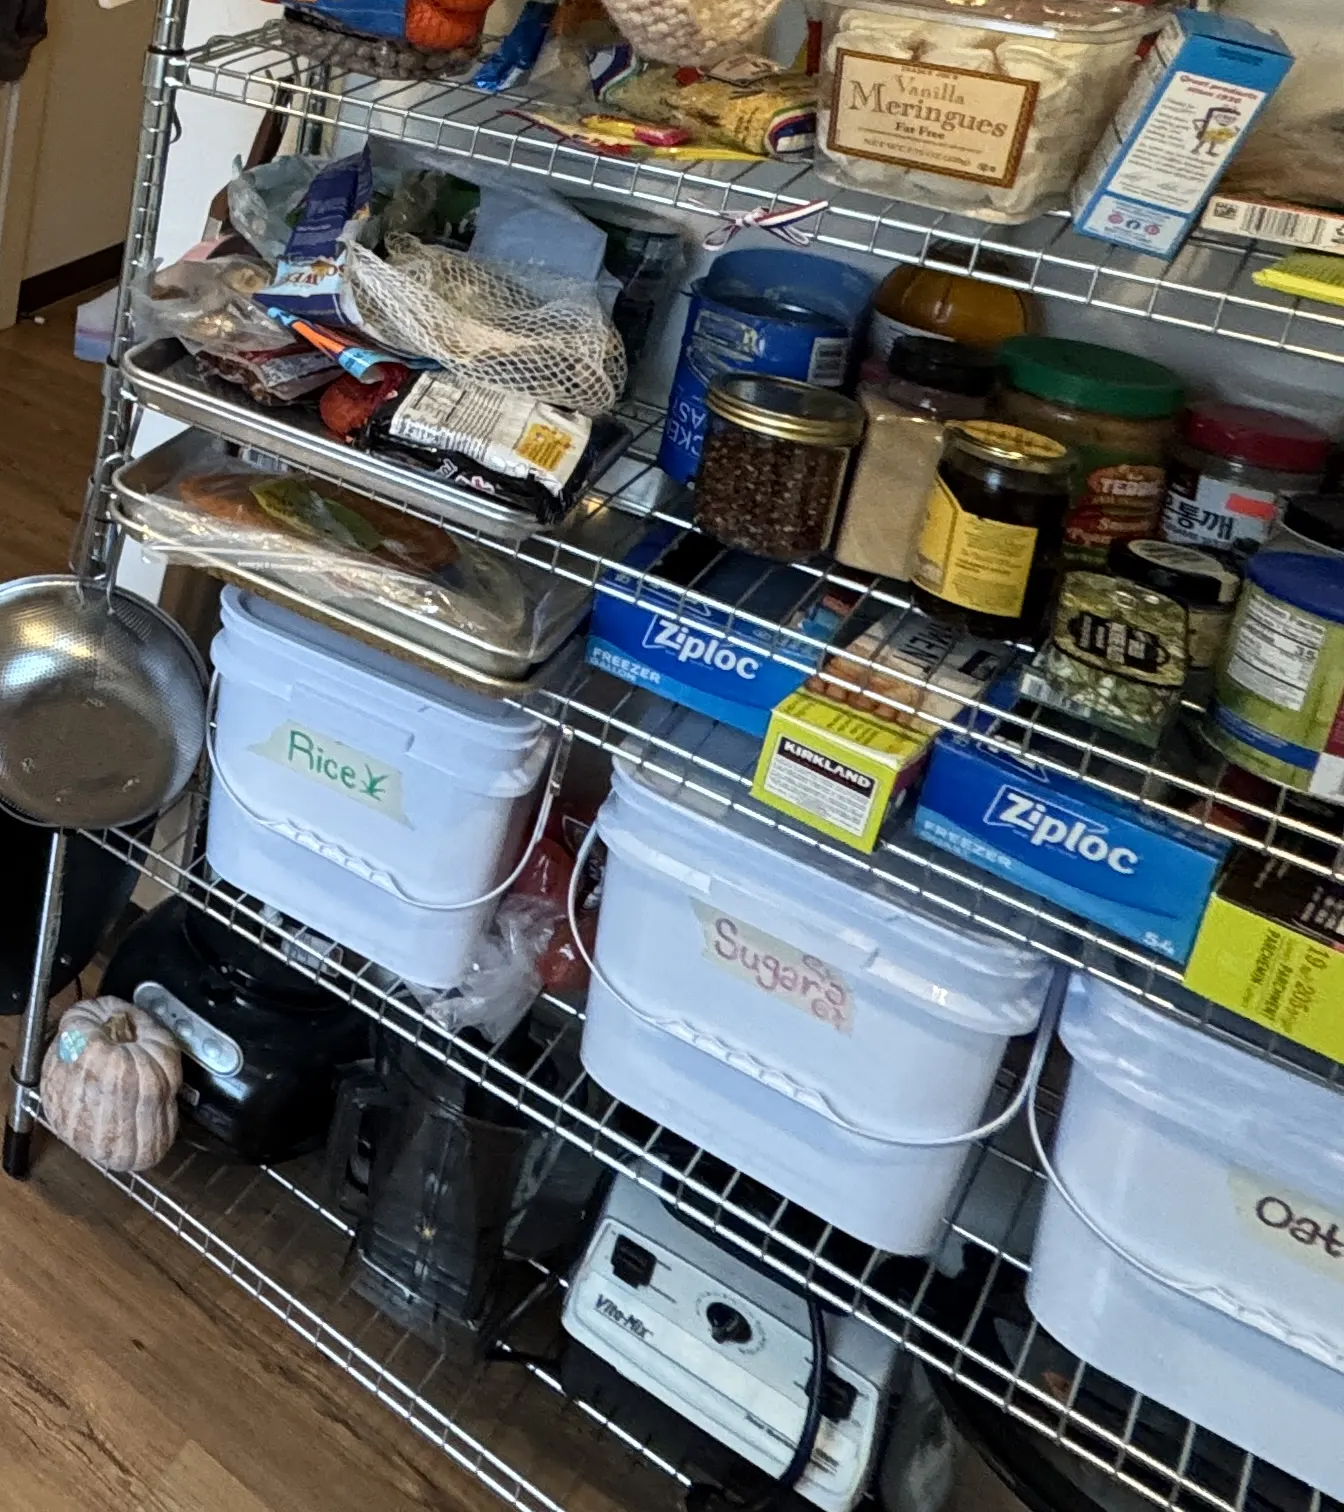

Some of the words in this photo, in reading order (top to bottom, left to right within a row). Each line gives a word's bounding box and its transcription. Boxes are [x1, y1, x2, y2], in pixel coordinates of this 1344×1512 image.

[848, 80, 1009, 138] Meringues
[893, 74, 965, 105] Vanilla
[895, 122, 915, 134] Fat
[918, 126, 945, 139] Free
[592, 647, 662, 685] FREEZER
[654, 619, 759, 681] Ziploc
[288, 730, 356, 789] Rice
[784, 742, 872, 789] KIRKLAND
[923, 820, 1013, 871] FREEZER
[999, 792, 1139, 875] Ziploc
